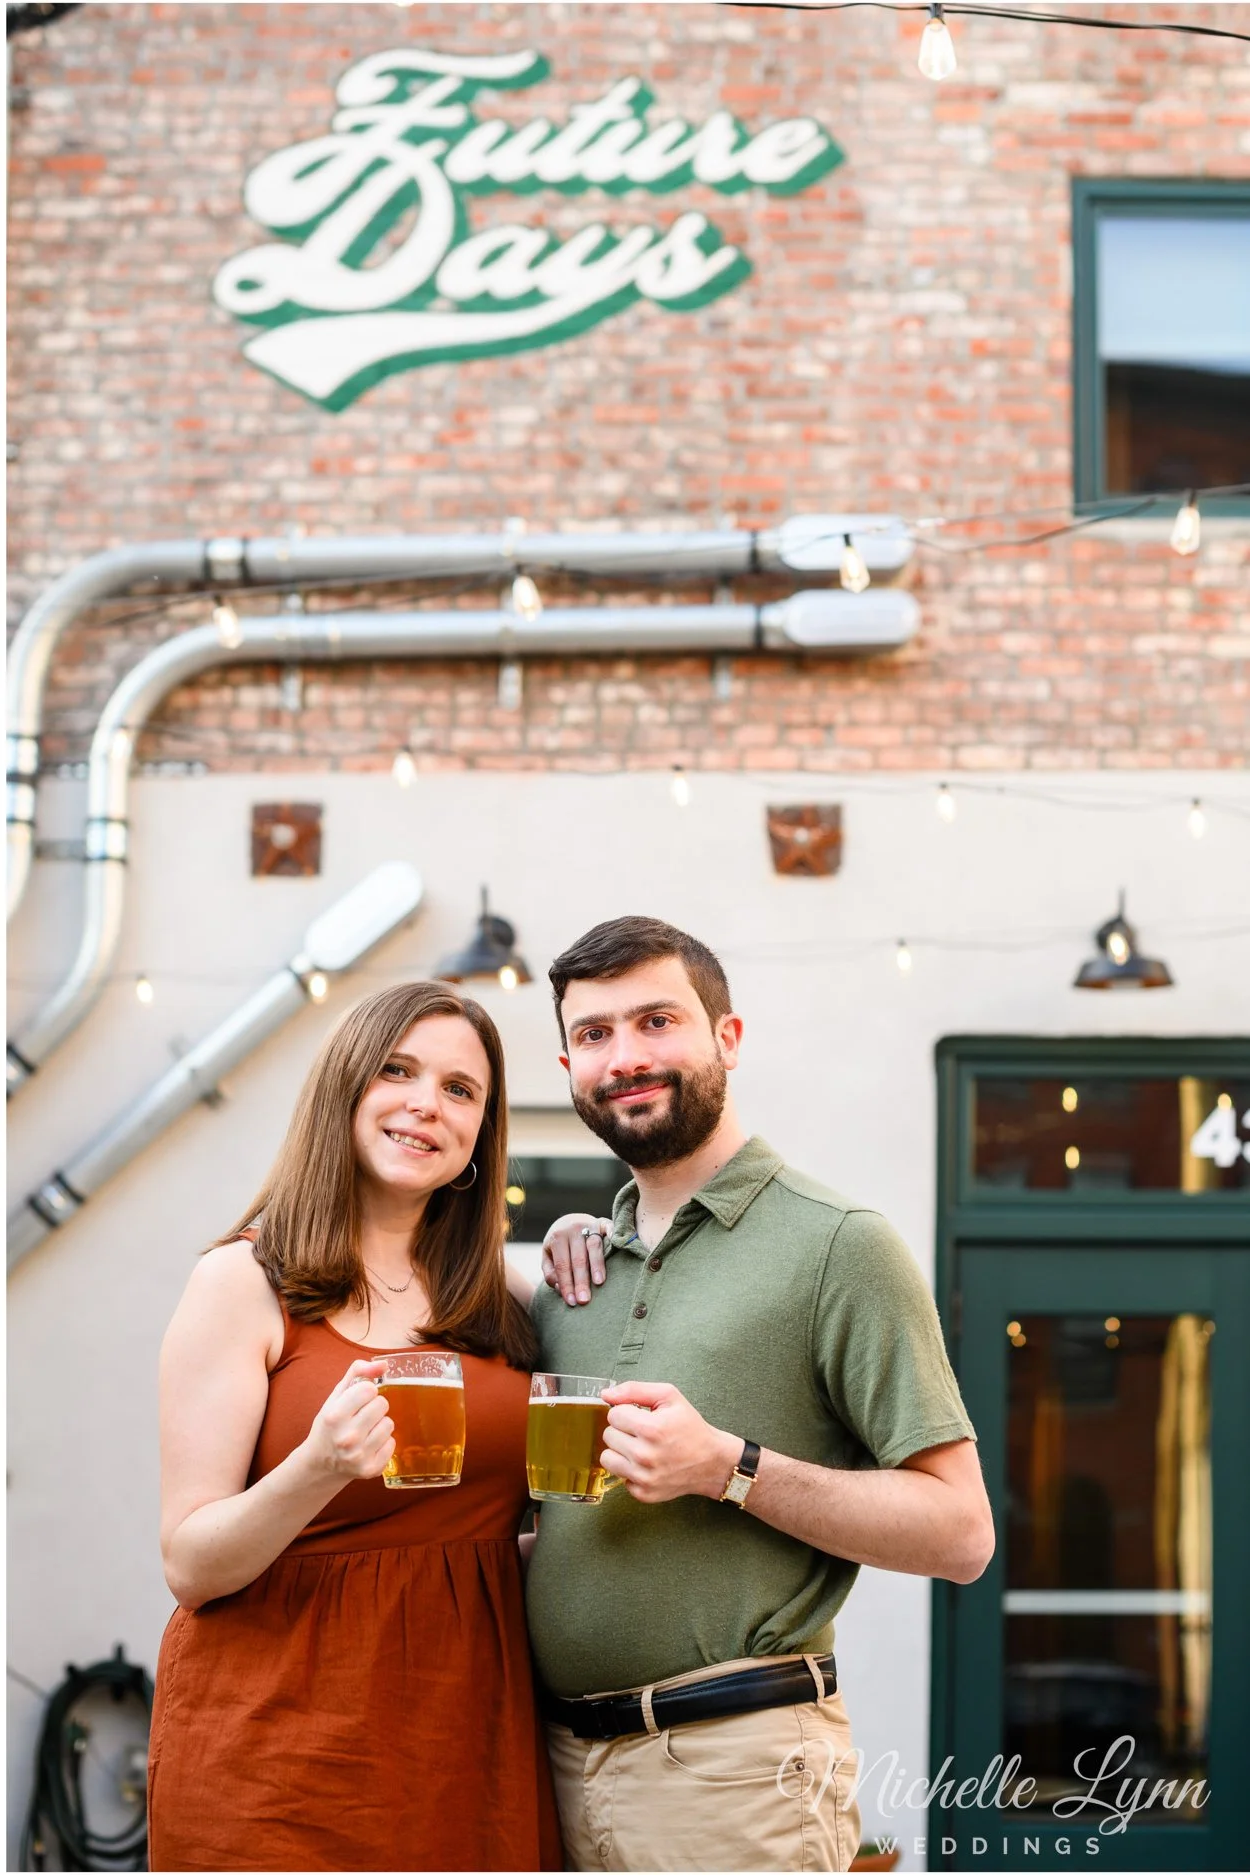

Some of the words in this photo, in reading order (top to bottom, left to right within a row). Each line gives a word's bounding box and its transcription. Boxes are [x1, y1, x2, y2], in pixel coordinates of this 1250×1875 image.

[245, 49, 845, 238] Future
[213, 160, 752, 413] Days
[1190, 1105, 1250, 1167] 4
